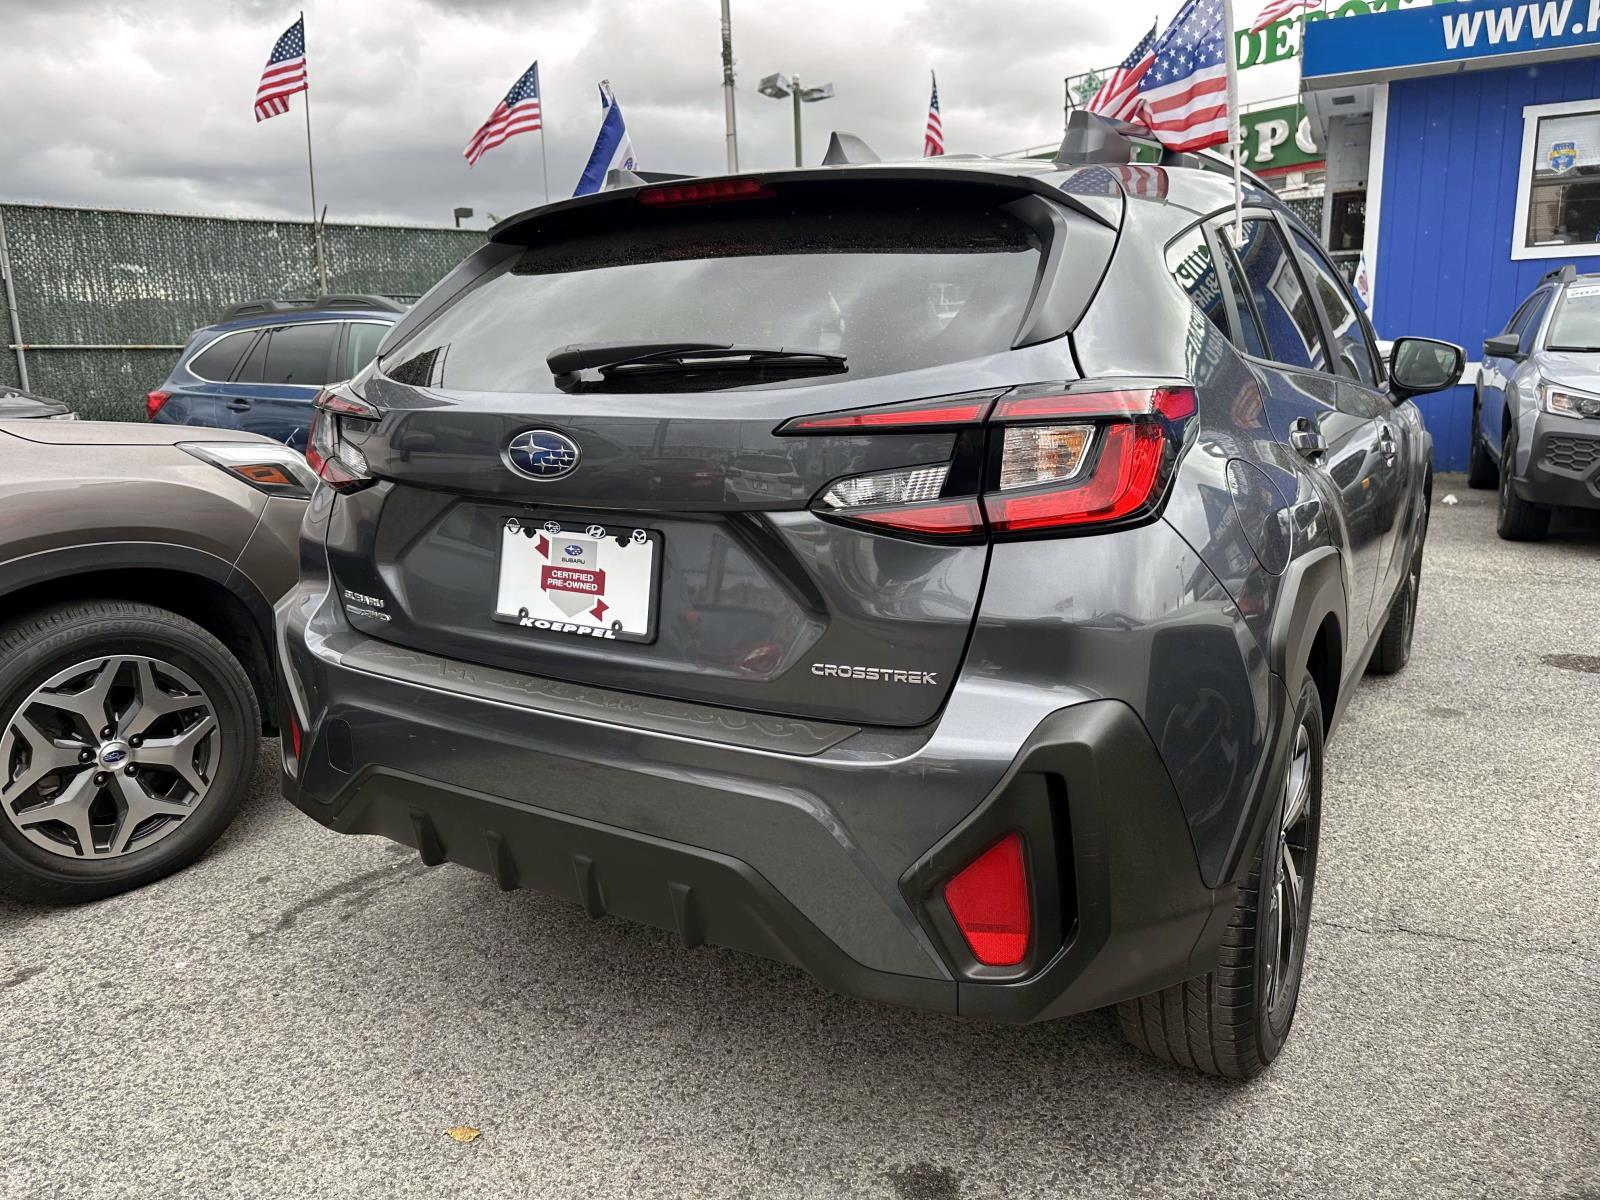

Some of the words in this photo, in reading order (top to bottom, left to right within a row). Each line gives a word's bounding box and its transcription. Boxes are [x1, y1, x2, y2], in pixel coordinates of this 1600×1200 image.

[561, 556, 586, 565] SUBARU
[551, 569, 594, 582] CERTIFIED
[547, 578, 598, 592] PRE-OWNED
[519, 617, 616, 640] KOEPPEL
[811, 663, 937, 685] CROSSTREK
